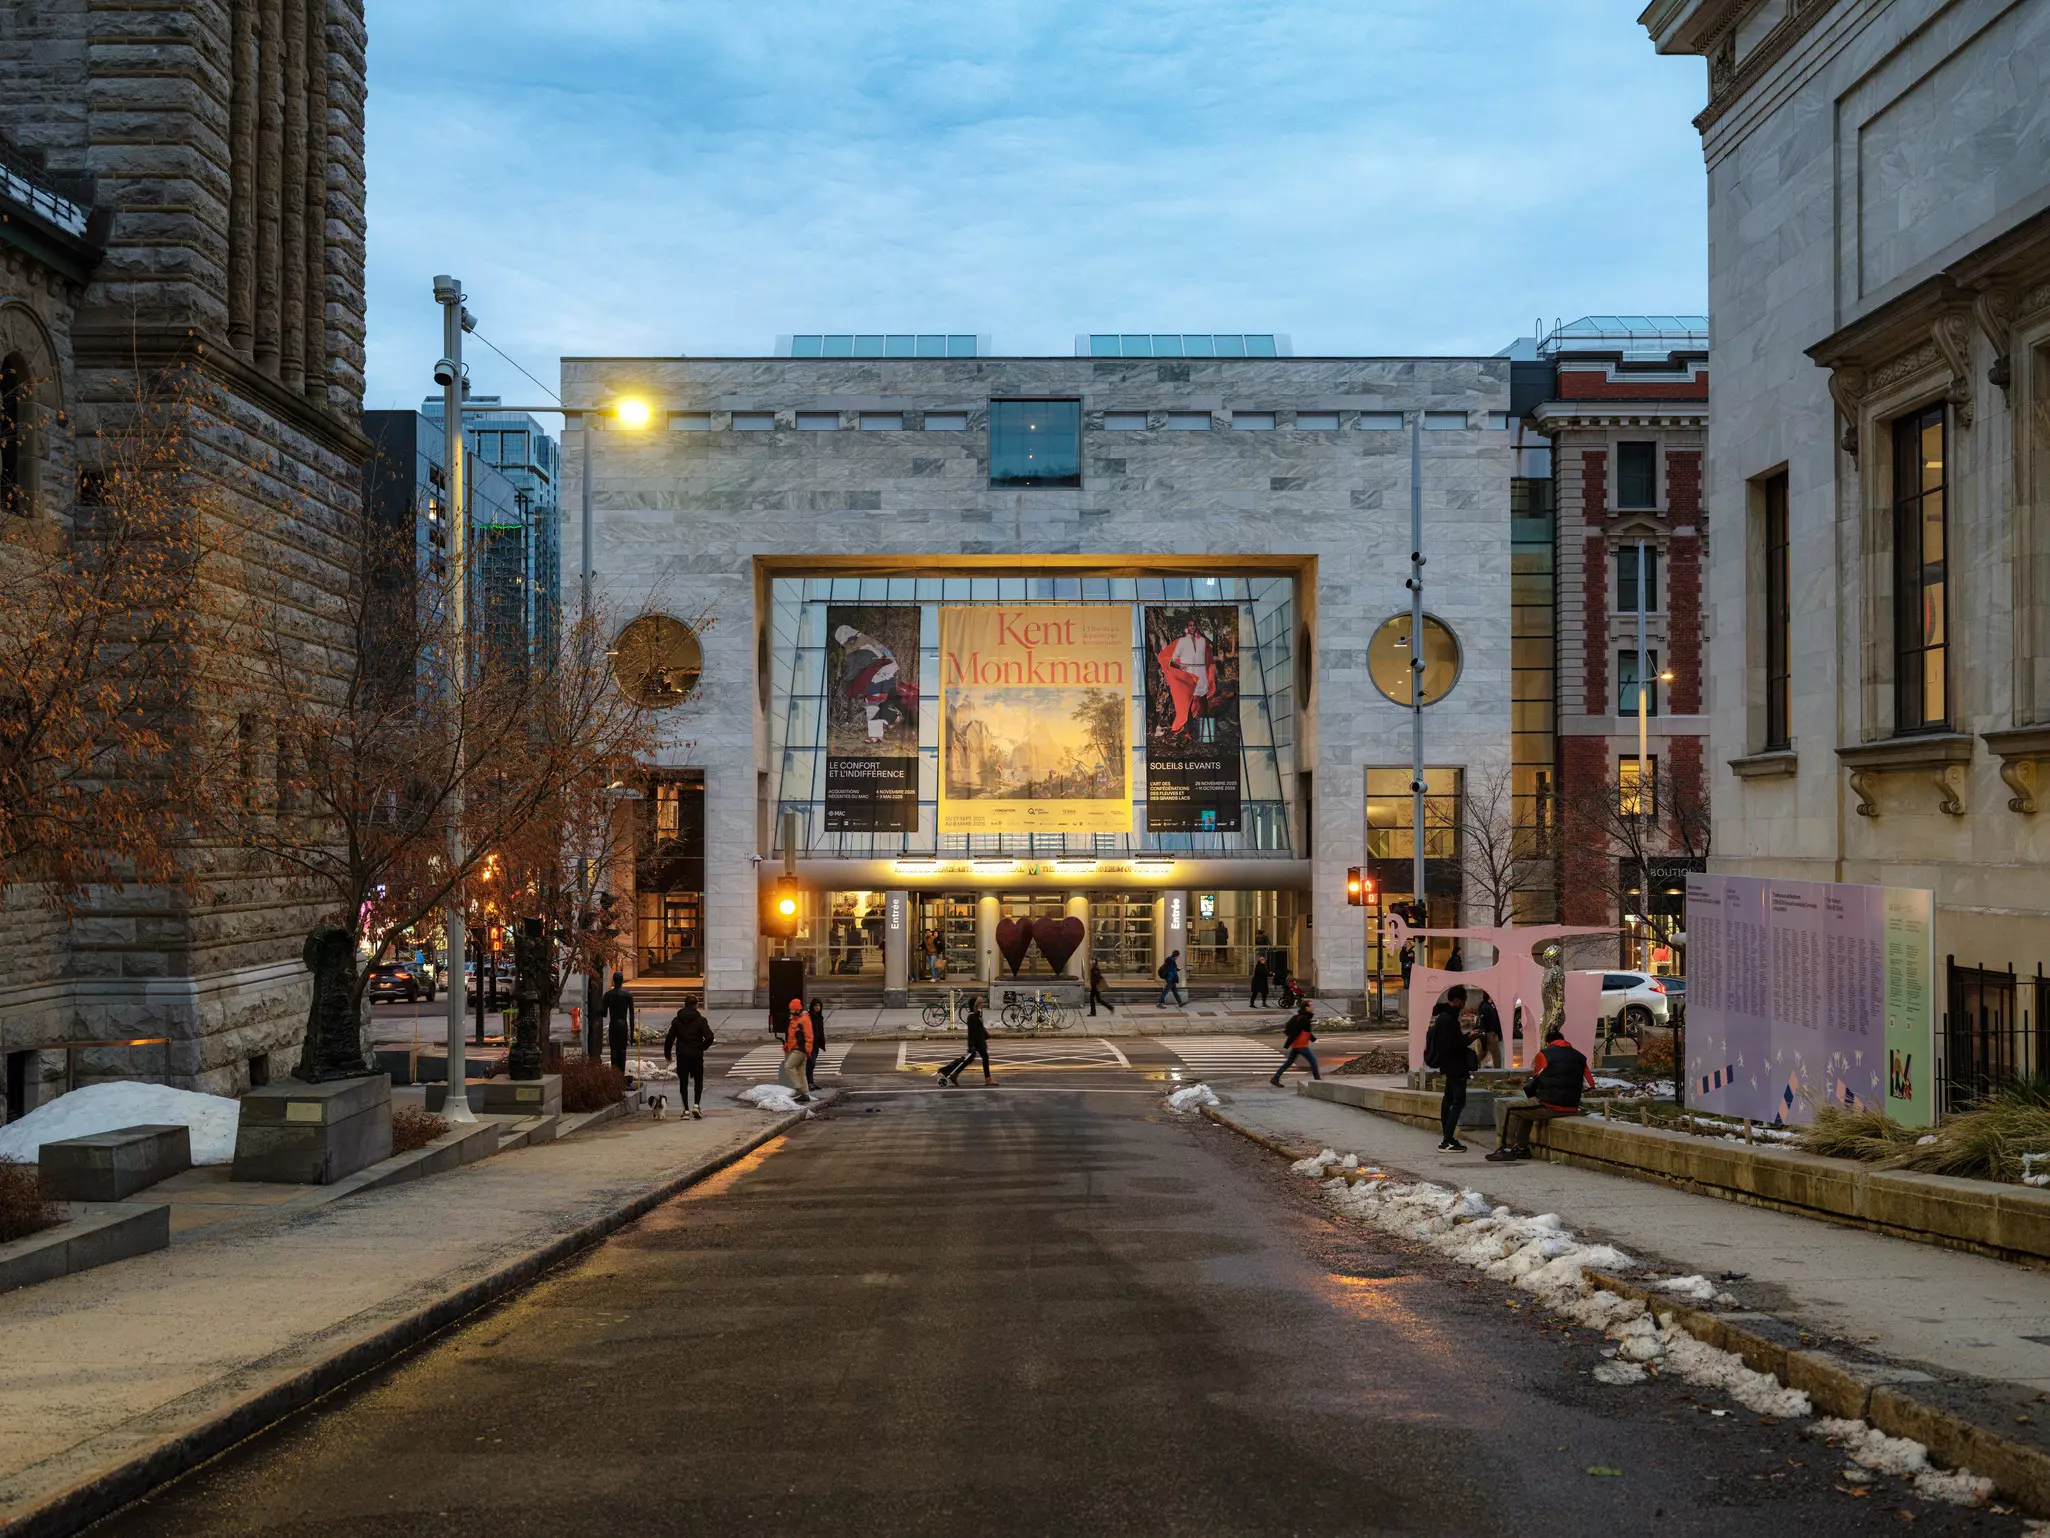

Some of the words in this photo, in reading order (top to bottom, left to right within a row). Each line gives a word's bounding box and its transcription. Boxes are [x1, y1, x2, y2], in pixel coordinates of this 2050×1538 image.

[998, 612, 1076, 649] Kent
[947, 650, 1123, 684] Monkman
[829, 761, 839, 770] LE
[840, 761, 880, 770] CONFORT
[829, 770, 839, 778] ET
[840, 768, 905, 778] L'INDIFFÉRENCE
[1149, 762, 1184, 770] SOLEILS
[1185, 761, 1221, 770] LEVANTS
[890, 898, 900, 929] Entrée
[1170, 897, 1181, 930] Entrée
